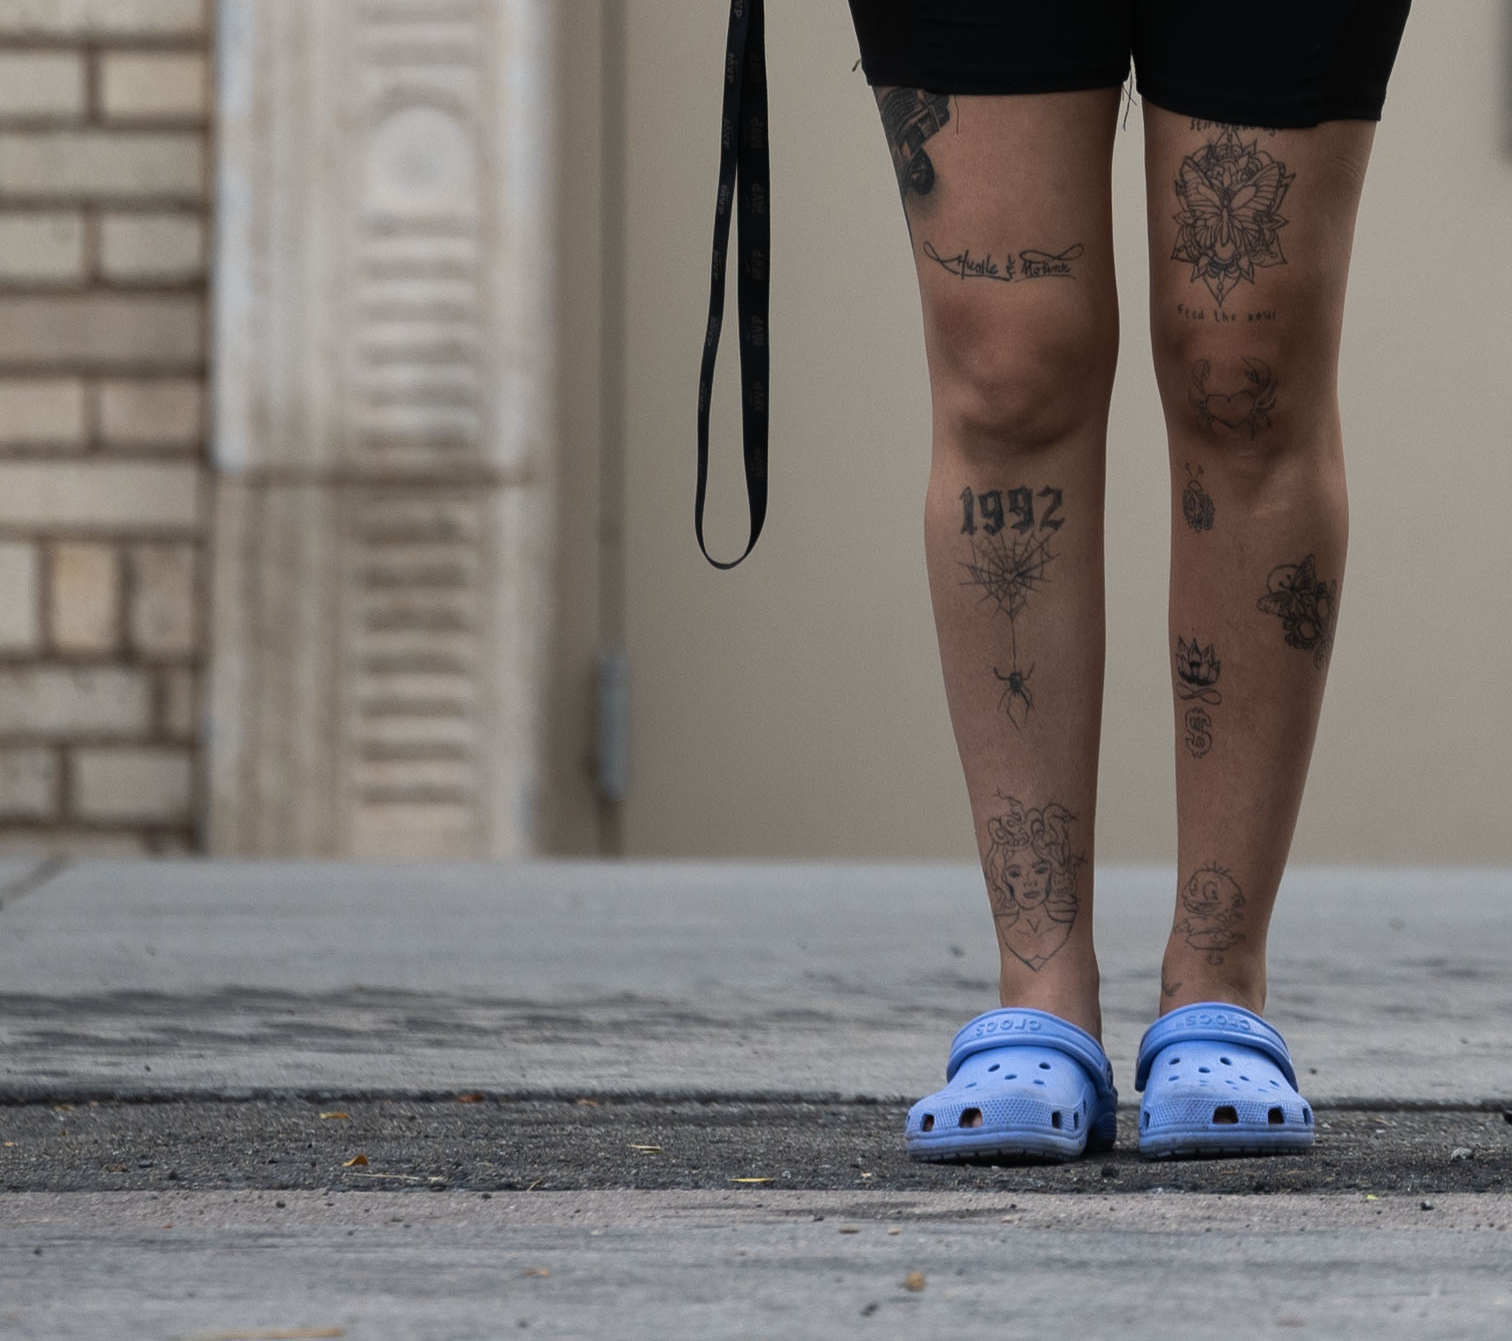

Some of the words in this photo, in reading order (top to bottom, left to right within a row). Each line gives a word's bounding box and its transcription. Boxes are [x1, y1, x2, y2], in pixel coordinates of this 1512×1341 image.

[1213, 308, 1237, 323] the
[960, 485, 1065, 536] 1992
[975, 1019, 1042, 1037] crocs
[1184, 1015, 1251, 1031] crocs
